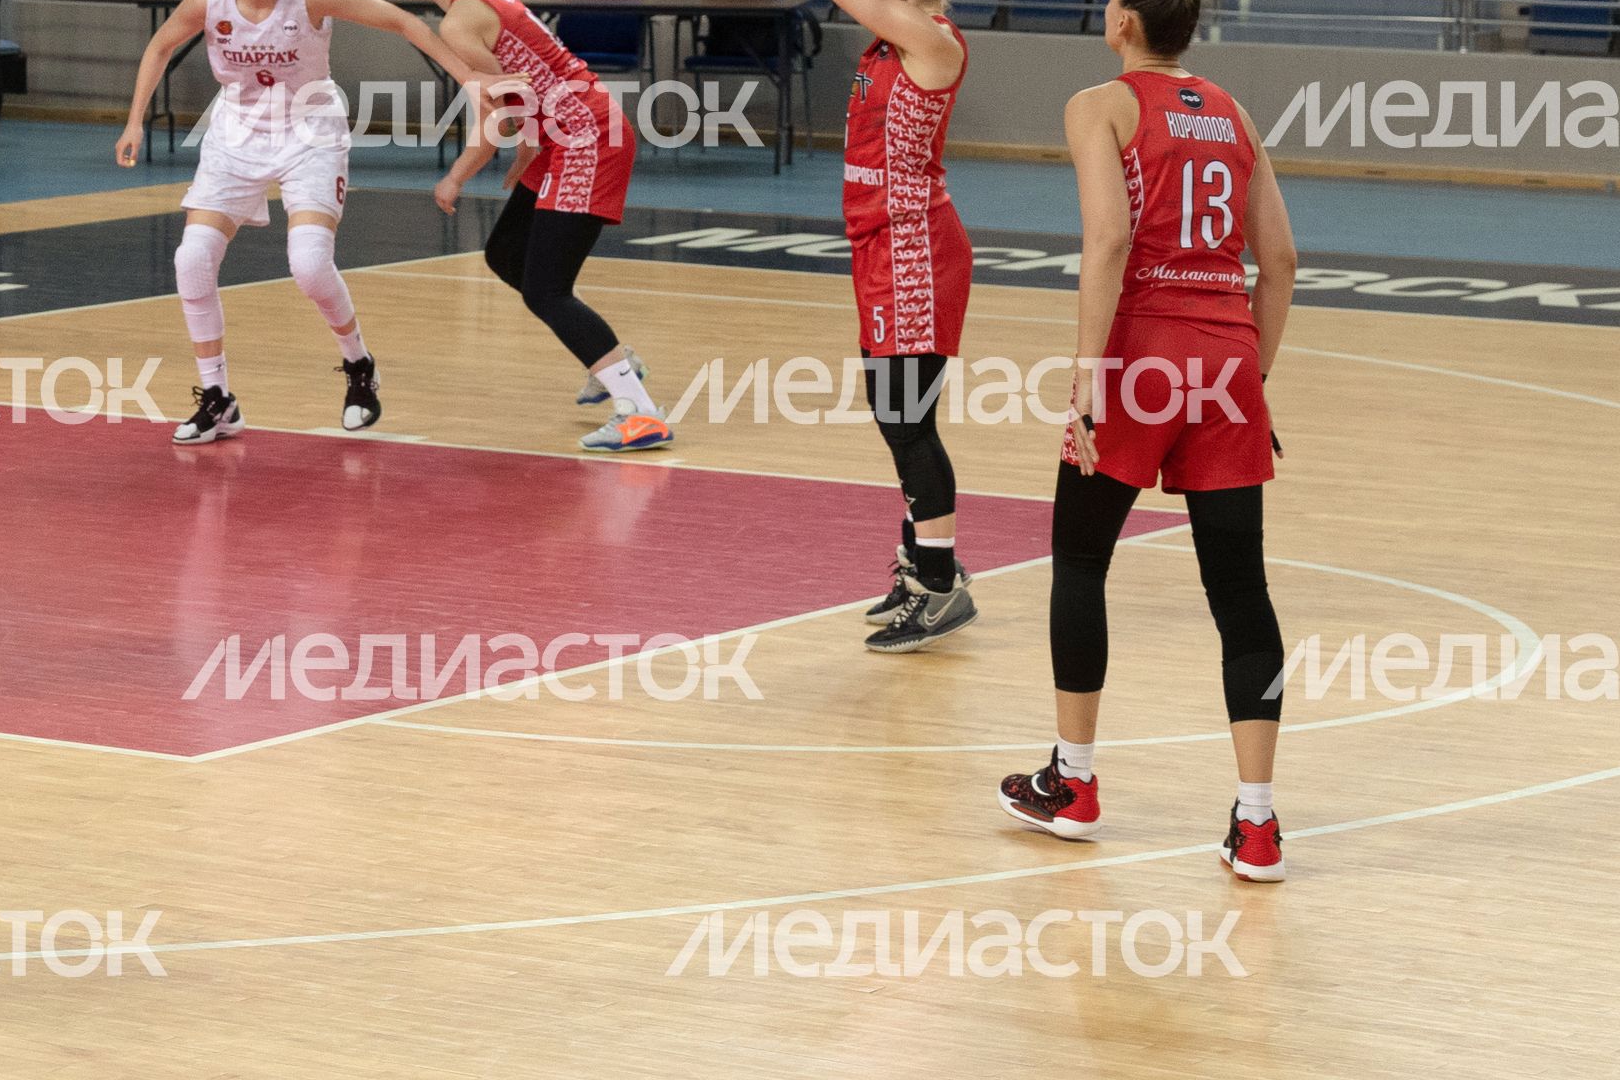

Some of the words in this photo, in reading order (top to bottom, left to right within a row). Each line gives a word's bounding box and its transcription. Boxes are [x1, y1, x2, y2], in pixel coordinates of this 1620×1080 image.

[222, 49, 300, 64] СПАРТАК
[255, 69, 276, 87] 6
[336, 175, 345, 205] 6
[1180, 159, 1235, 251] 13
[873, 305, 885, 343] 5
